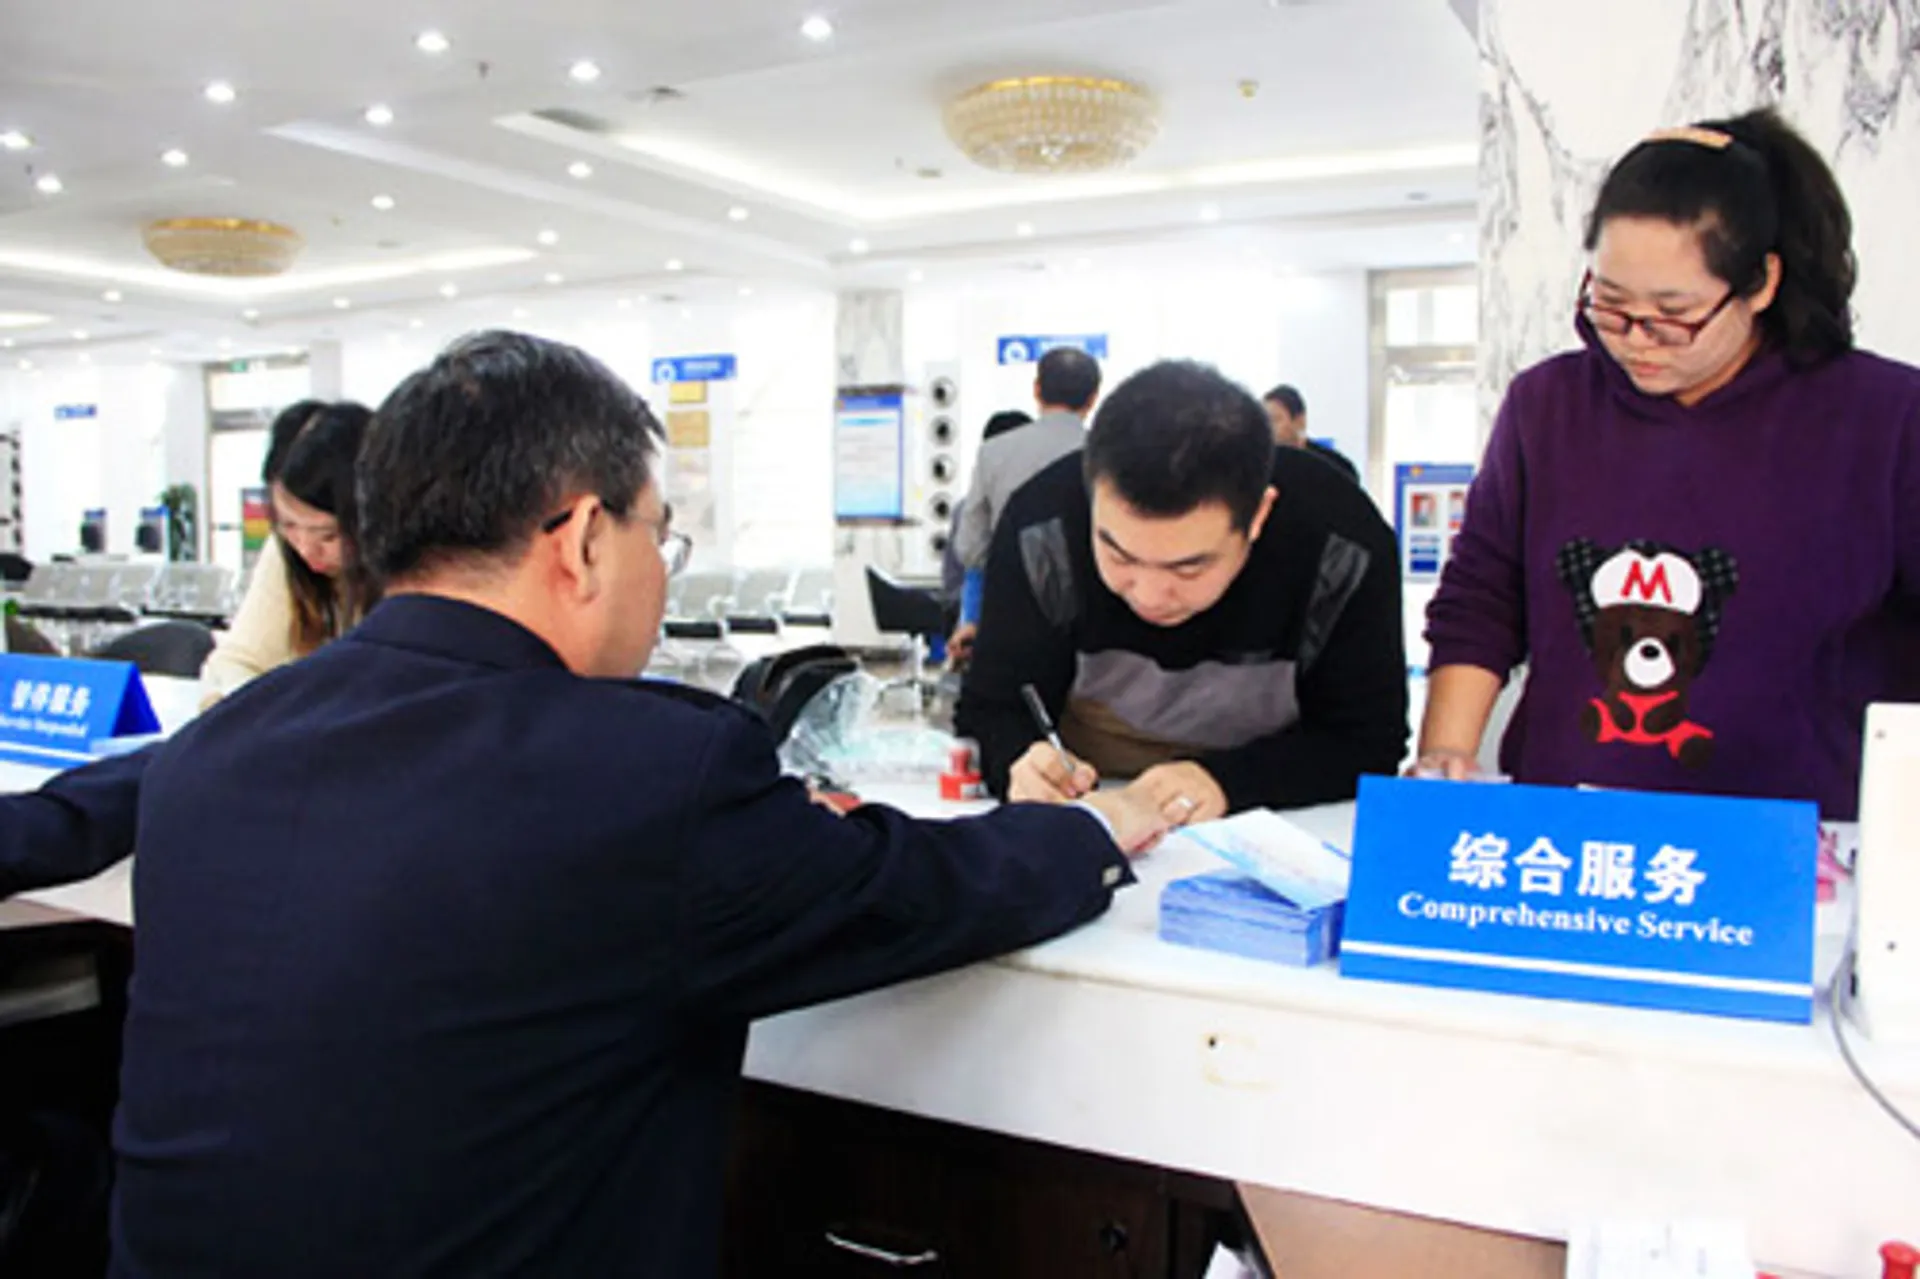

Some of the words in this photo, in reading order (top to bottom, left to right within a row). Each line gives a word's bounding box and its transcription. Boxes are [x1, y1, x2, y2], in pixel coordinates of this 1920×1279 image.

[1622, 561, 1673, 603] M
[1448, 831, 1707, 906] 综合服务
[1398, 892, 1631, 935] Comprehensive
[1636, 911, 1754, 946] Service
